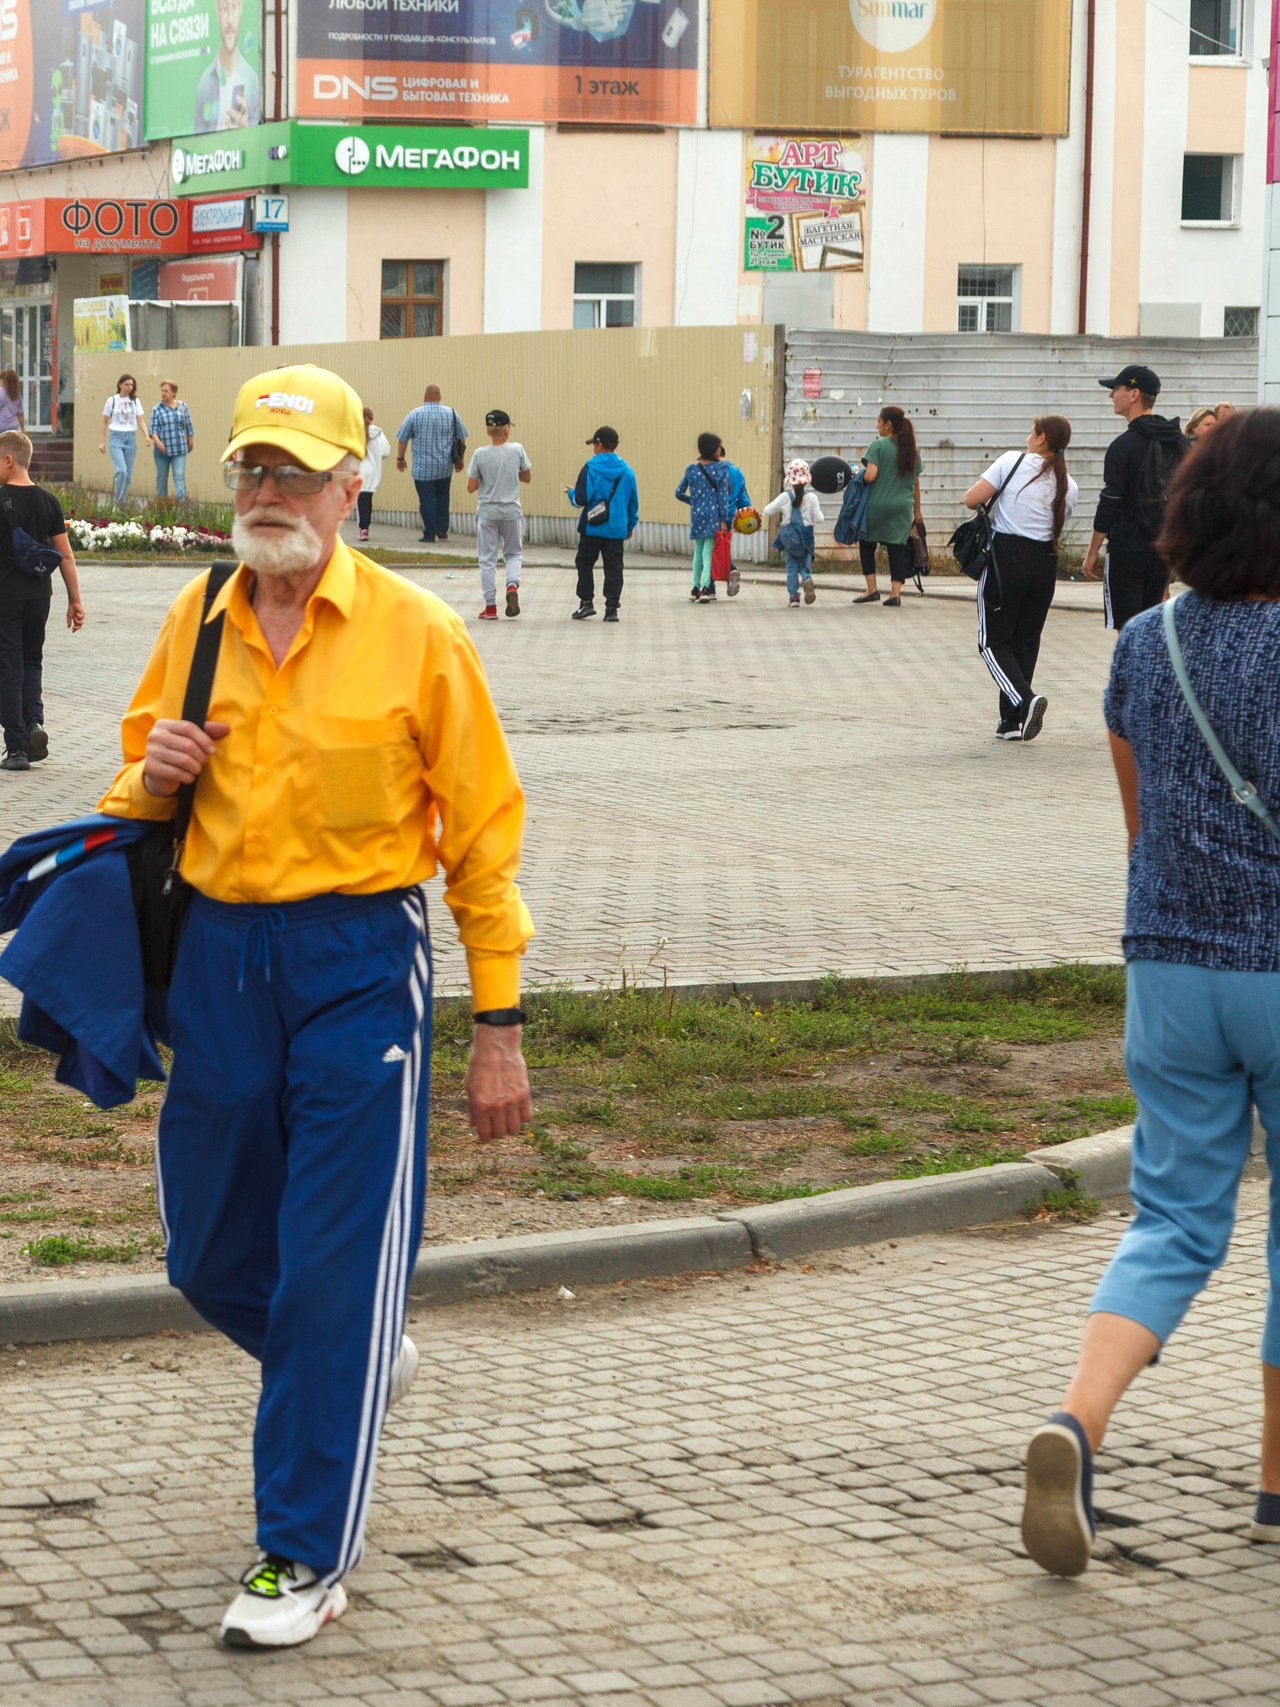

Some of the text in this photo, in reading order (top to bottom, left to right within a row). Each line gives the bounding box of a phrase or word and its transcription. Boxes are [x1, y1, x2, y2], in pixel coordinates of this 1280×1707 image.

[151, 13, 209, 48] НА СВЯЗИ
[328, 31, 383, 42] ПОДРОБНОСТИ
[838, 65, 945, 81] ТУРАГЕНТСТВО
[312, 74, 398, 100] DNS
[402, 76, 480, 91] ЦИФРОВАЯ И
[575, 75, 640, 97] 1 этаж
[402, 89, 510, 104] БЫТОВАЯ ТЕХНИКА
[825, 85, 957, 102] ВЫГОДНЫХ ТУРОВ
[780, 141, 842, 168] АРТ
[751, 161, 861, 199] БУТИК
[263, 199, 285, 219] 17
[61, 199, 179, 238] ФОТО
[805, 221, 854, 235] БАГЕТНАЯ
[74, 239, 161, 251] на документы
[750, 241, 784, 250] БУТИК
[799, 232, 861, 246] МАСТЕРСКАЯ
[254, 392, 315, 415] FENDI
